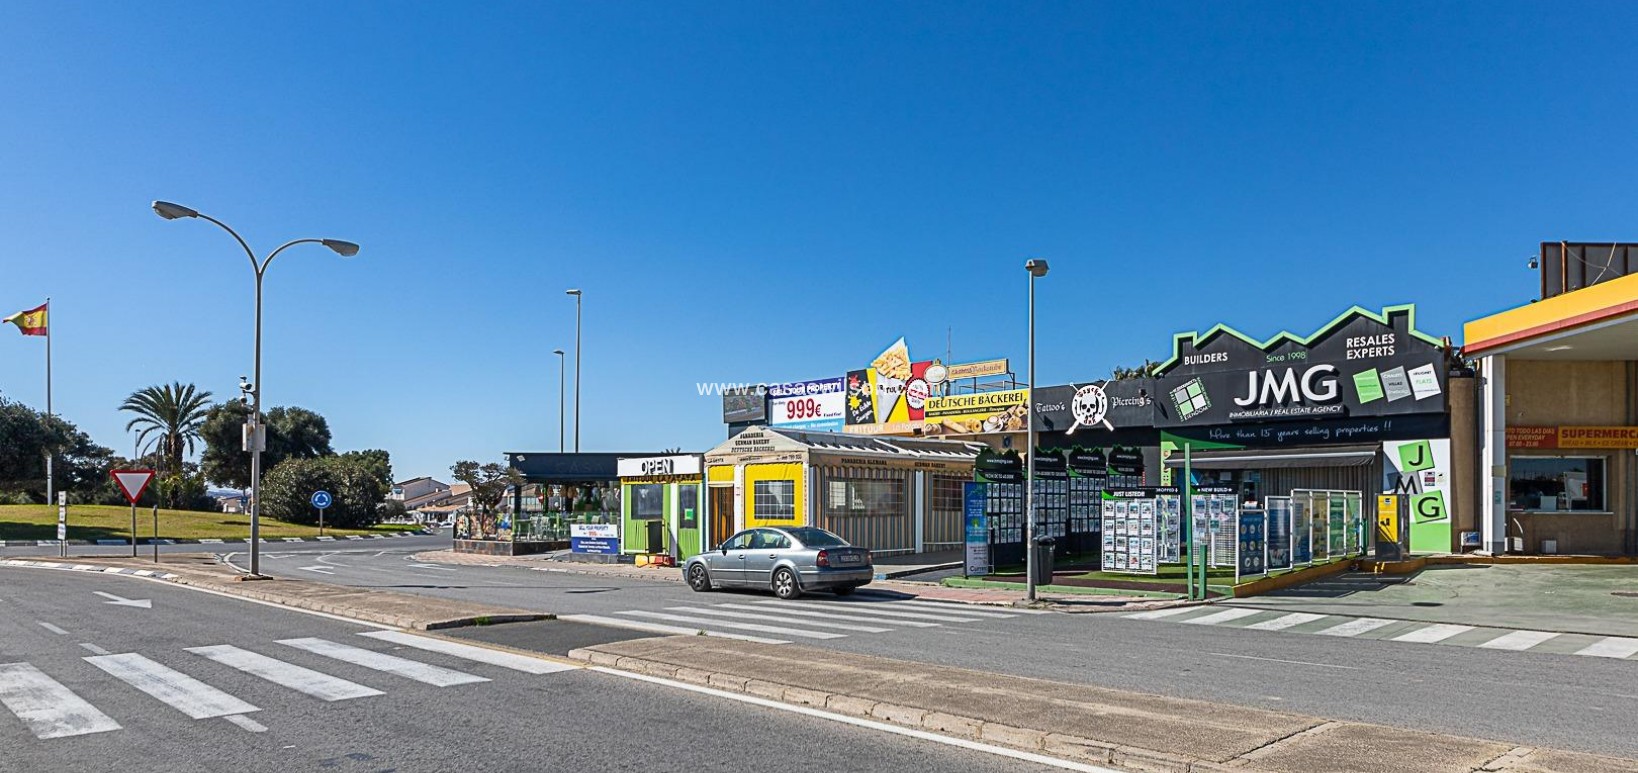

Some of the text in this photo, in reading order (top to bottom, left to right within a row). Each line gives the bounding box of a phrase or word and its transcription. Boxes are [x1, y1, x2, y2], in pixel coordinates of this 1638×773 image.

[1346, 334, 1395, 348] RESALES
[1184, 352, 1228, 366] BUILDERS
[1266, 352, 1306, 363] Since 1998
[1346, 346, 1395, 360] EXPERTS
[1234, 364, 1338, 406] JMG
[928, 397, 976, 409] DEUTSCHE
[978, 392, 1023, 404] BÄCKEREI
[787, 398, 822, 420] 999€
[1230, 409, 1268, 418] INMOBILIARIA
[1290, 407, 1312, 415] ESTATE
[1312, 406, 1342, 414] AGENCY
[1209, 430, 1231, 440] More
[1236, 429, 1255, 438] than
[1277, 429, 1299, 441] years
[1304, 426, 1330, 440] selling
[1336, 424, 1378, 440] properties
[1562, 430, 1638, 438] SUPERMERC
[1408, 445, 1424, 466] J
[642, 459, 672, 475] OPEN
[1394, 475, 1418, 494] M
[1418, 496, 1440, 518] G
